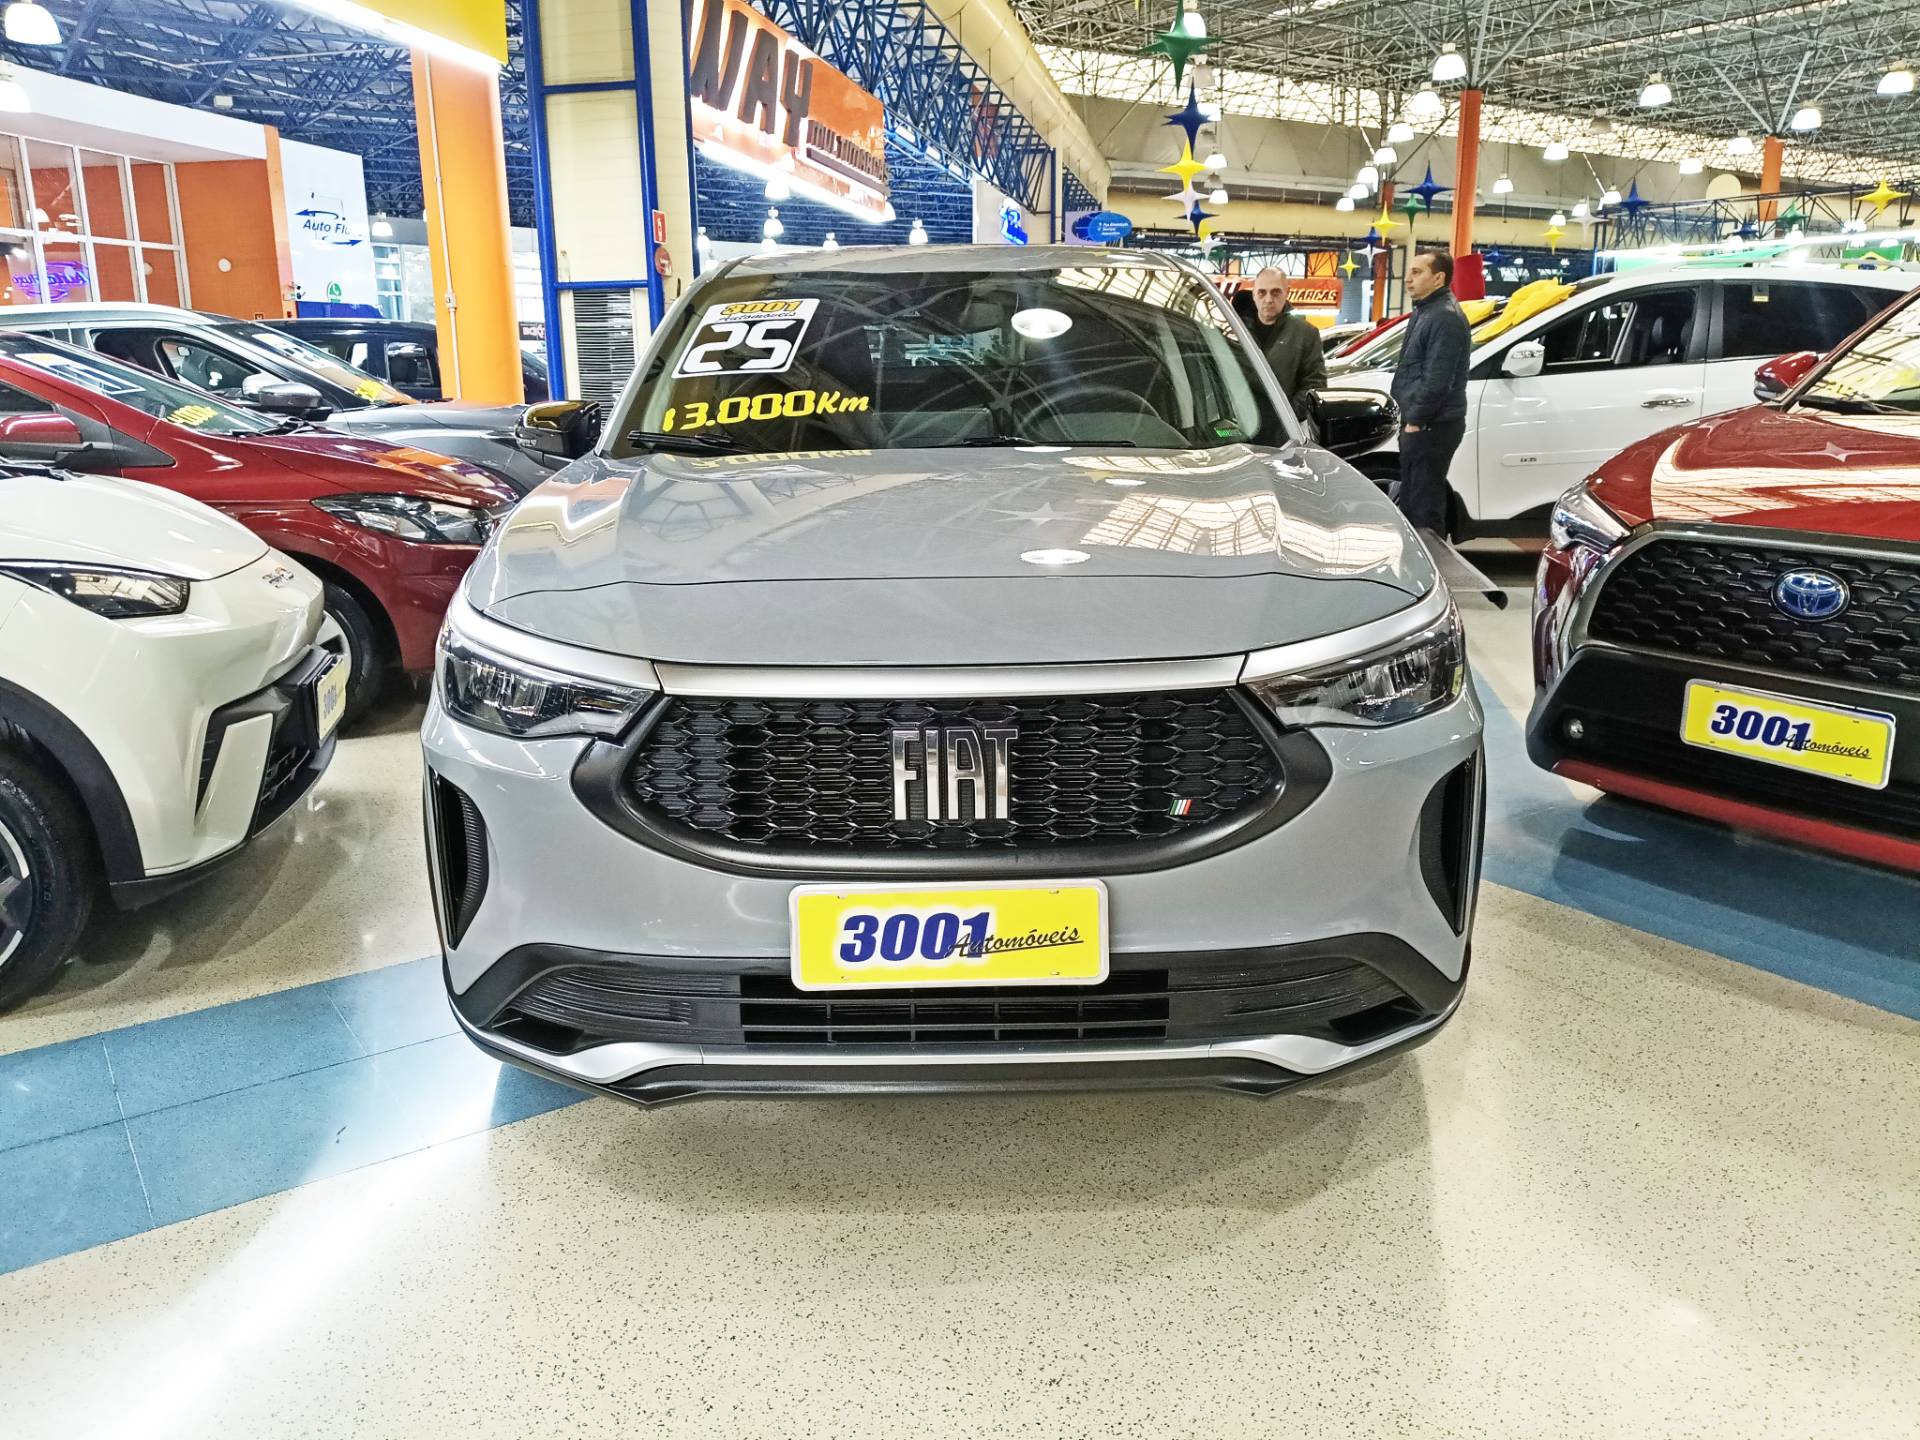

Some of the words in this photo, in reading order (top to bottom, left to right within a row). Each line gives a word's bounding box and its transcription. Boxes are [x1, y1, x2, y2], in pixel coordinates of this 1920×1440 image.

[303, 218, 331, 233] Auto
[720, 300, 803, 316] 3001
[681, 319, 798, 372] 25
[1711, 704, 1811, 752] 3001
[1783, 733, 1871, 758] Automóveis
[892, 729, 1018, 820] FIAT
[839, 911, 990, 963] 3001
[944, 926, 1083, 958] Automóveis
